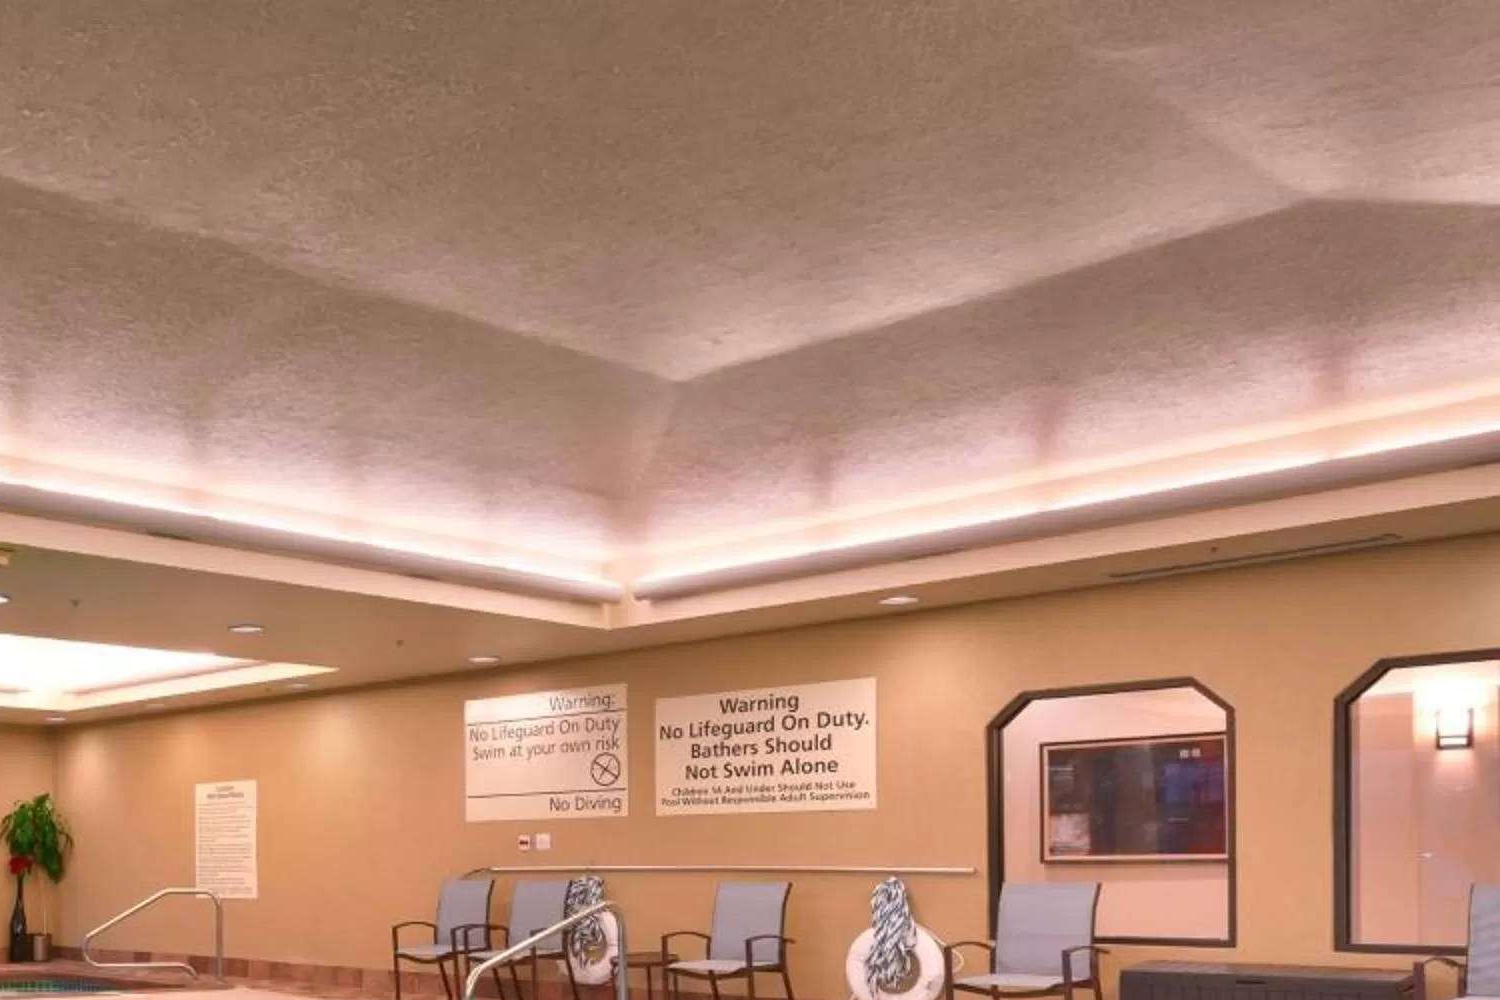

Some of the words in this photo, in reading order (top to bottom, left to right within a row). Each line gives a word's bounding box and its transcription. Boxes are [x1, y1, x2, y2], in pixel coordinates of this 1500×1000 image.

[719, 694, 799, 714] Warning
[469, 728, 489, 742] No
[491, 720, 555, 742] Lifeguard
[559, 720, 579, 735] On
[585, 716, 620, 735] Duty
[659, 726, 683, 740] No
[689, 716, 775, 740] Lifeguard
[781, 715, 809, 731] On
[817, 711, 869, 730] Duty.
[472, 745, 505, 761] Swim
[509, 746, 523, 758] at
[526, 744, 556, 761] your
[560, 741, 591, 753] own
[595, 735, 620, 751] risk
[691, 741, 758, 759] Bathers
[765, 734, 832, 755] Should
[685, 765, 718, 780] Not
[723, 759, 774, 779] Swim
[780, 758, 839, 776] Alone
[549, 797, 571, 812] No
[575, 797, 621, 813] Diving
